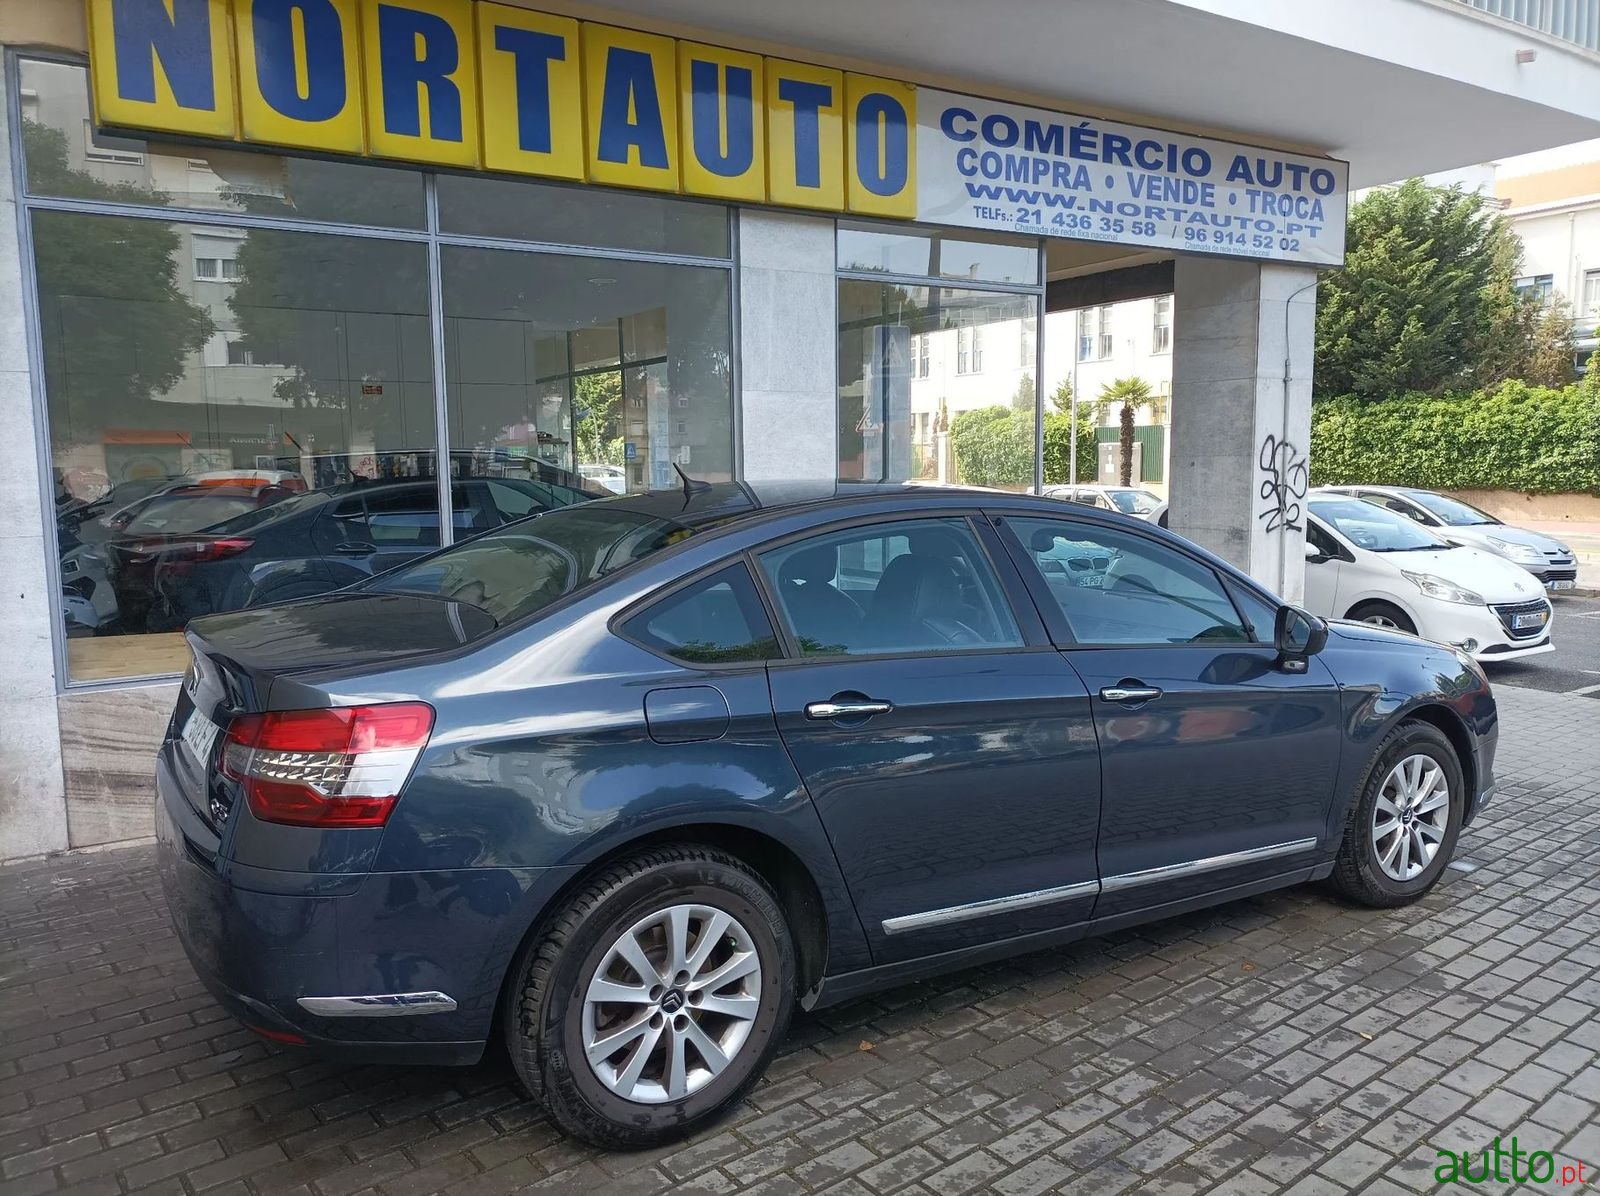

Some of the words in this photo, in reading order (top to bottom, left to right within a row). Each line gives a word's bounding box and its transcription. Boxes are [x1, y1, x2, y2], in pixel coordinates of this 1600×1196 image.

[114, 0, 910, 197] NORTAUTO
[940, 107, 1212, 177] COMÉRCIO
[1225, 154, 1336, 196] AUTO
[956, 147, 1092, 192] COMPRA
[1126, 171, 1215, 208] VENDE
[1245, 188, 1325, 222] TROCA
[964, 182, 1322, 238] WWW.NORTAUTO.PT
[1014, 223, 1049, 235] Chamada
[1050, 226, 1059, 235] de
[1060, 228, 1076, 237] rede
[1077, 229, 1090, 238] fixa
[1090, 231, 1118, 241] nacional
[1016, 207, 1042, 225] 21
[1051, 212, 1092, 230] 436
[1099, 216, 1125, 234] 35
[1131, 221, 1156, 237] 58
[1184, 227, 1207, 242] 96
[1213, 230, 1246, 246] 914
[1252, 234, 1273, 249] 52
[1279, 237, 1300, 252] 02
[1184, 241, 1211, 251] Chamada
